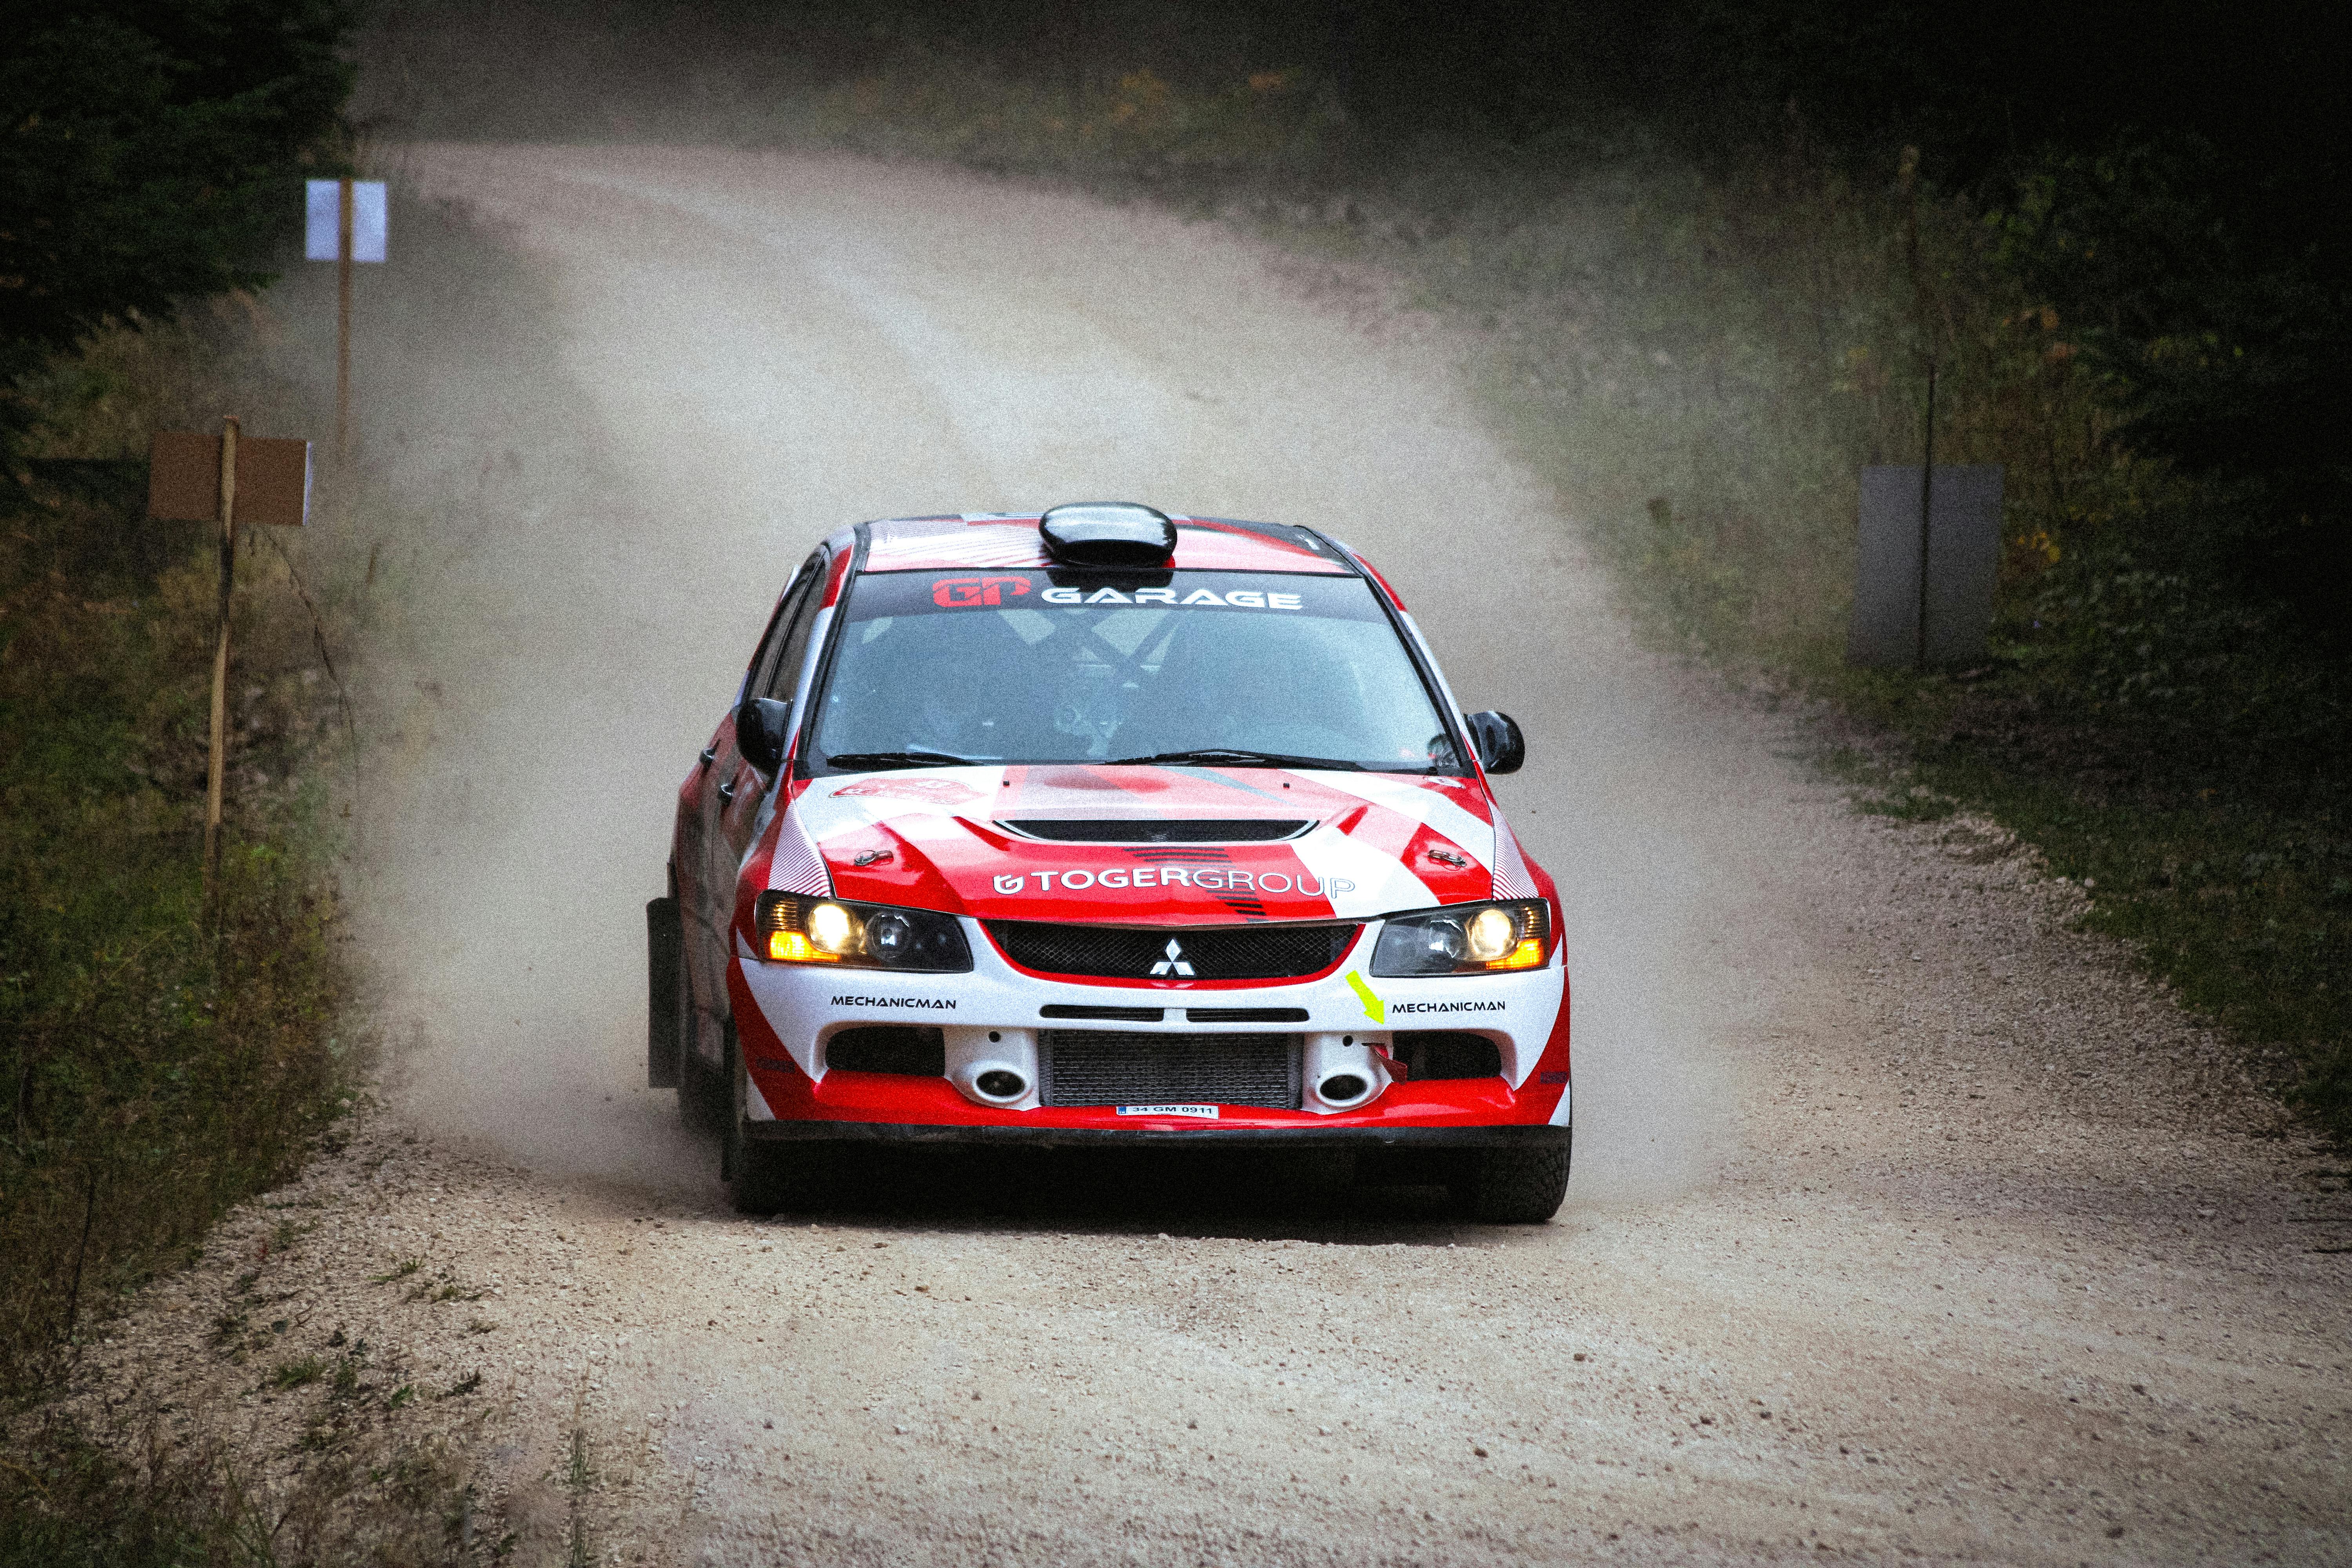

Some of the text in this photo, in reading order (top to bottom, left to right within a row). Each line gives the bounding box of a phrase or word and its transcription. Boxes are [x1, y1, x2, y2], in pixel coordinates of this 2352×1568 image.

[932, 576, 1302, 610] GP GARAGE
[831, 996, 956, 1009] MECHANICMAN
[1392, 1001, 1505, 1013] MECHANICMAN
